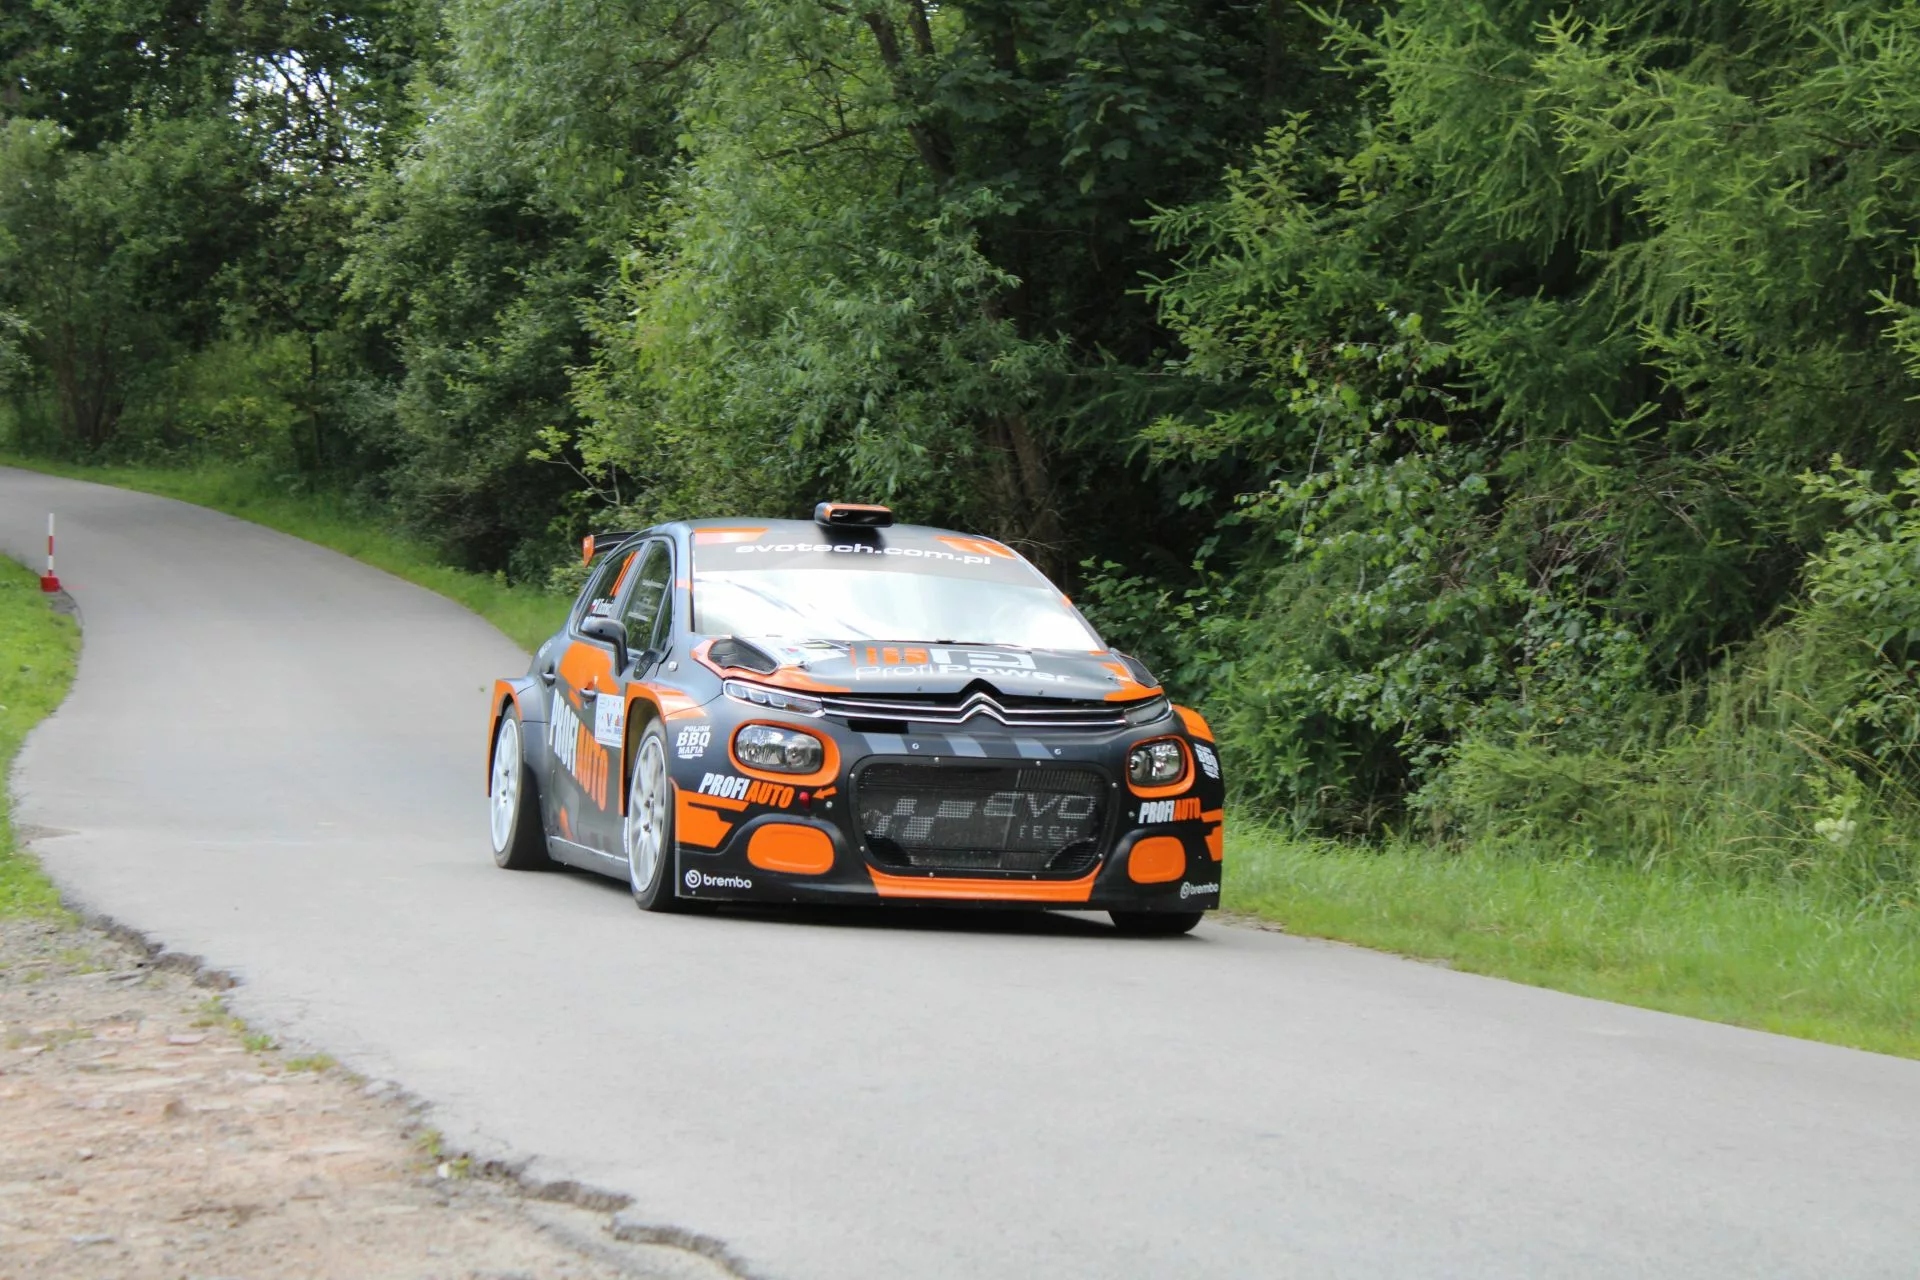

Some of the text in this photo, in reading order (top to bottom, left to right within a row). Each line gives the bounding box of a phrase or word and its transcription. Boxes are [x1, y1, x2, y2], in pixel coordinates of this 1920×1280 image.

[735, 543, 992, 566] evotech.com.pl
[675, 732, 711, 748] BBQ
[549, 688, 608, 811] PROFIAUTO
[677, 746, 704, 755] MAFIA
[698, 772, 796, 809] PROFIAUTO
[703, 873, 752, 889] brembo
[1189, 882, 1219, 895] brembo
